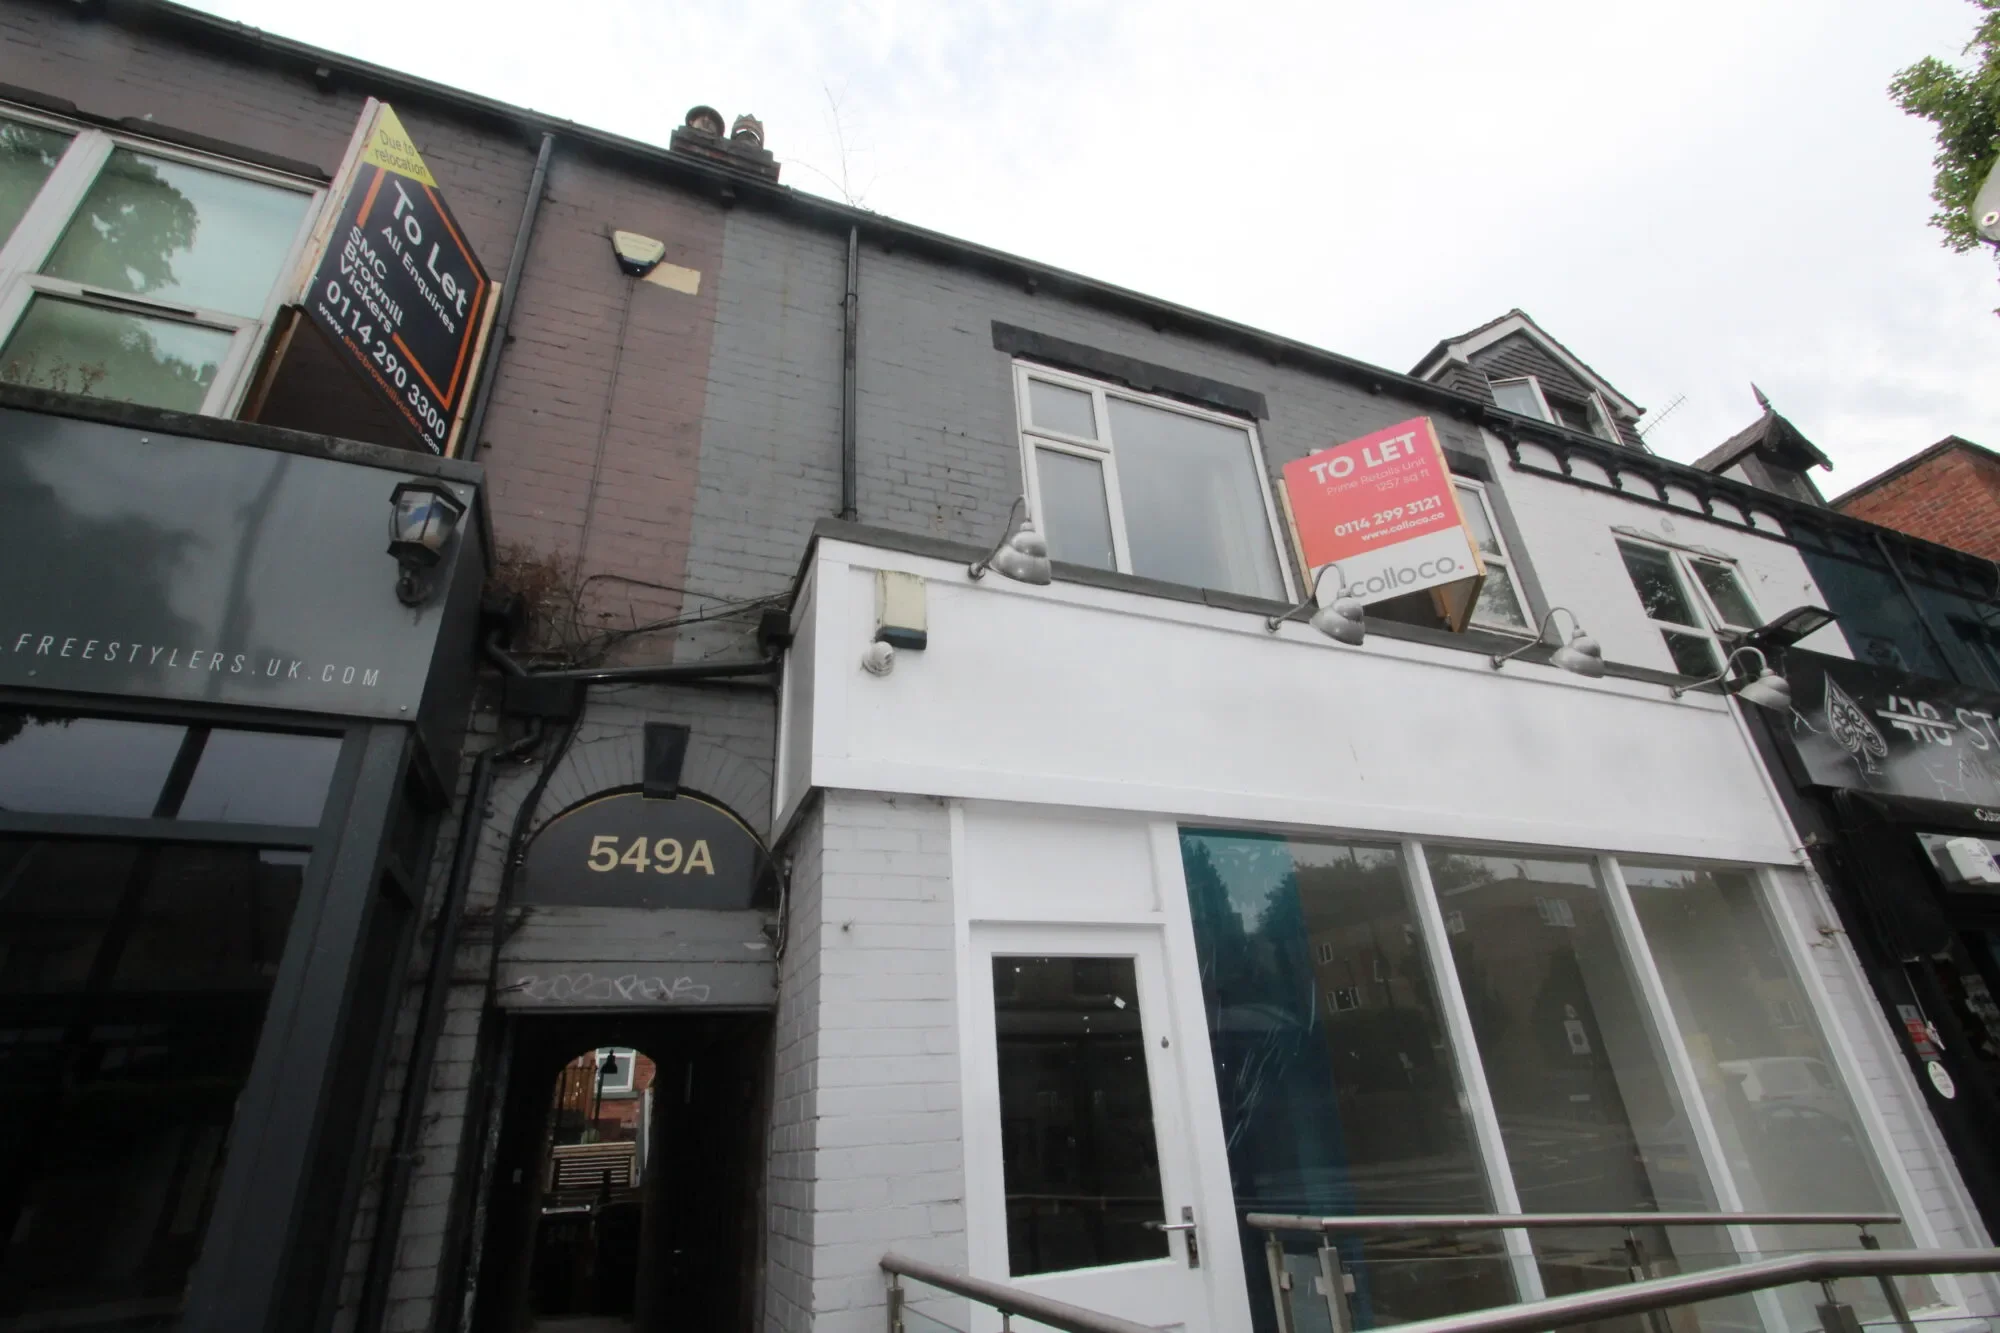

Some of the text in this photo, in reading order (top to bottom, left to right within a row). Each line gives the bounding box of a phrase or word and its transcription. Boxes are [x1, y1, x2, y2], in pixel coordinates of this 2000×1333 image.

[375, 148, 427, 177] relocation
[380, 129, 415, 156] Due to
[350, 226, 388, 280] SMC
[340, 254, 393, 333] Vickers
[344, 240, 403, 327] Brownill
[381, 226, 455, 334] All Enquiries
[427, 242, 467, 318] Let
[327, 280, 446, 439] 0114 290 3300
[1309, 432, 1416, 484] TO LET
[1326, 481, 1358, 496] Prime
[1402, 457, 1427, 470] Unit
[1375, 469, 1430, 492] 1257 sq ft
[1334, 495, 1442, 537] 0114 299 3121
[1361, 511, 1445, 541] www.colloco.co
[587, 835, 715, 876] 549A
